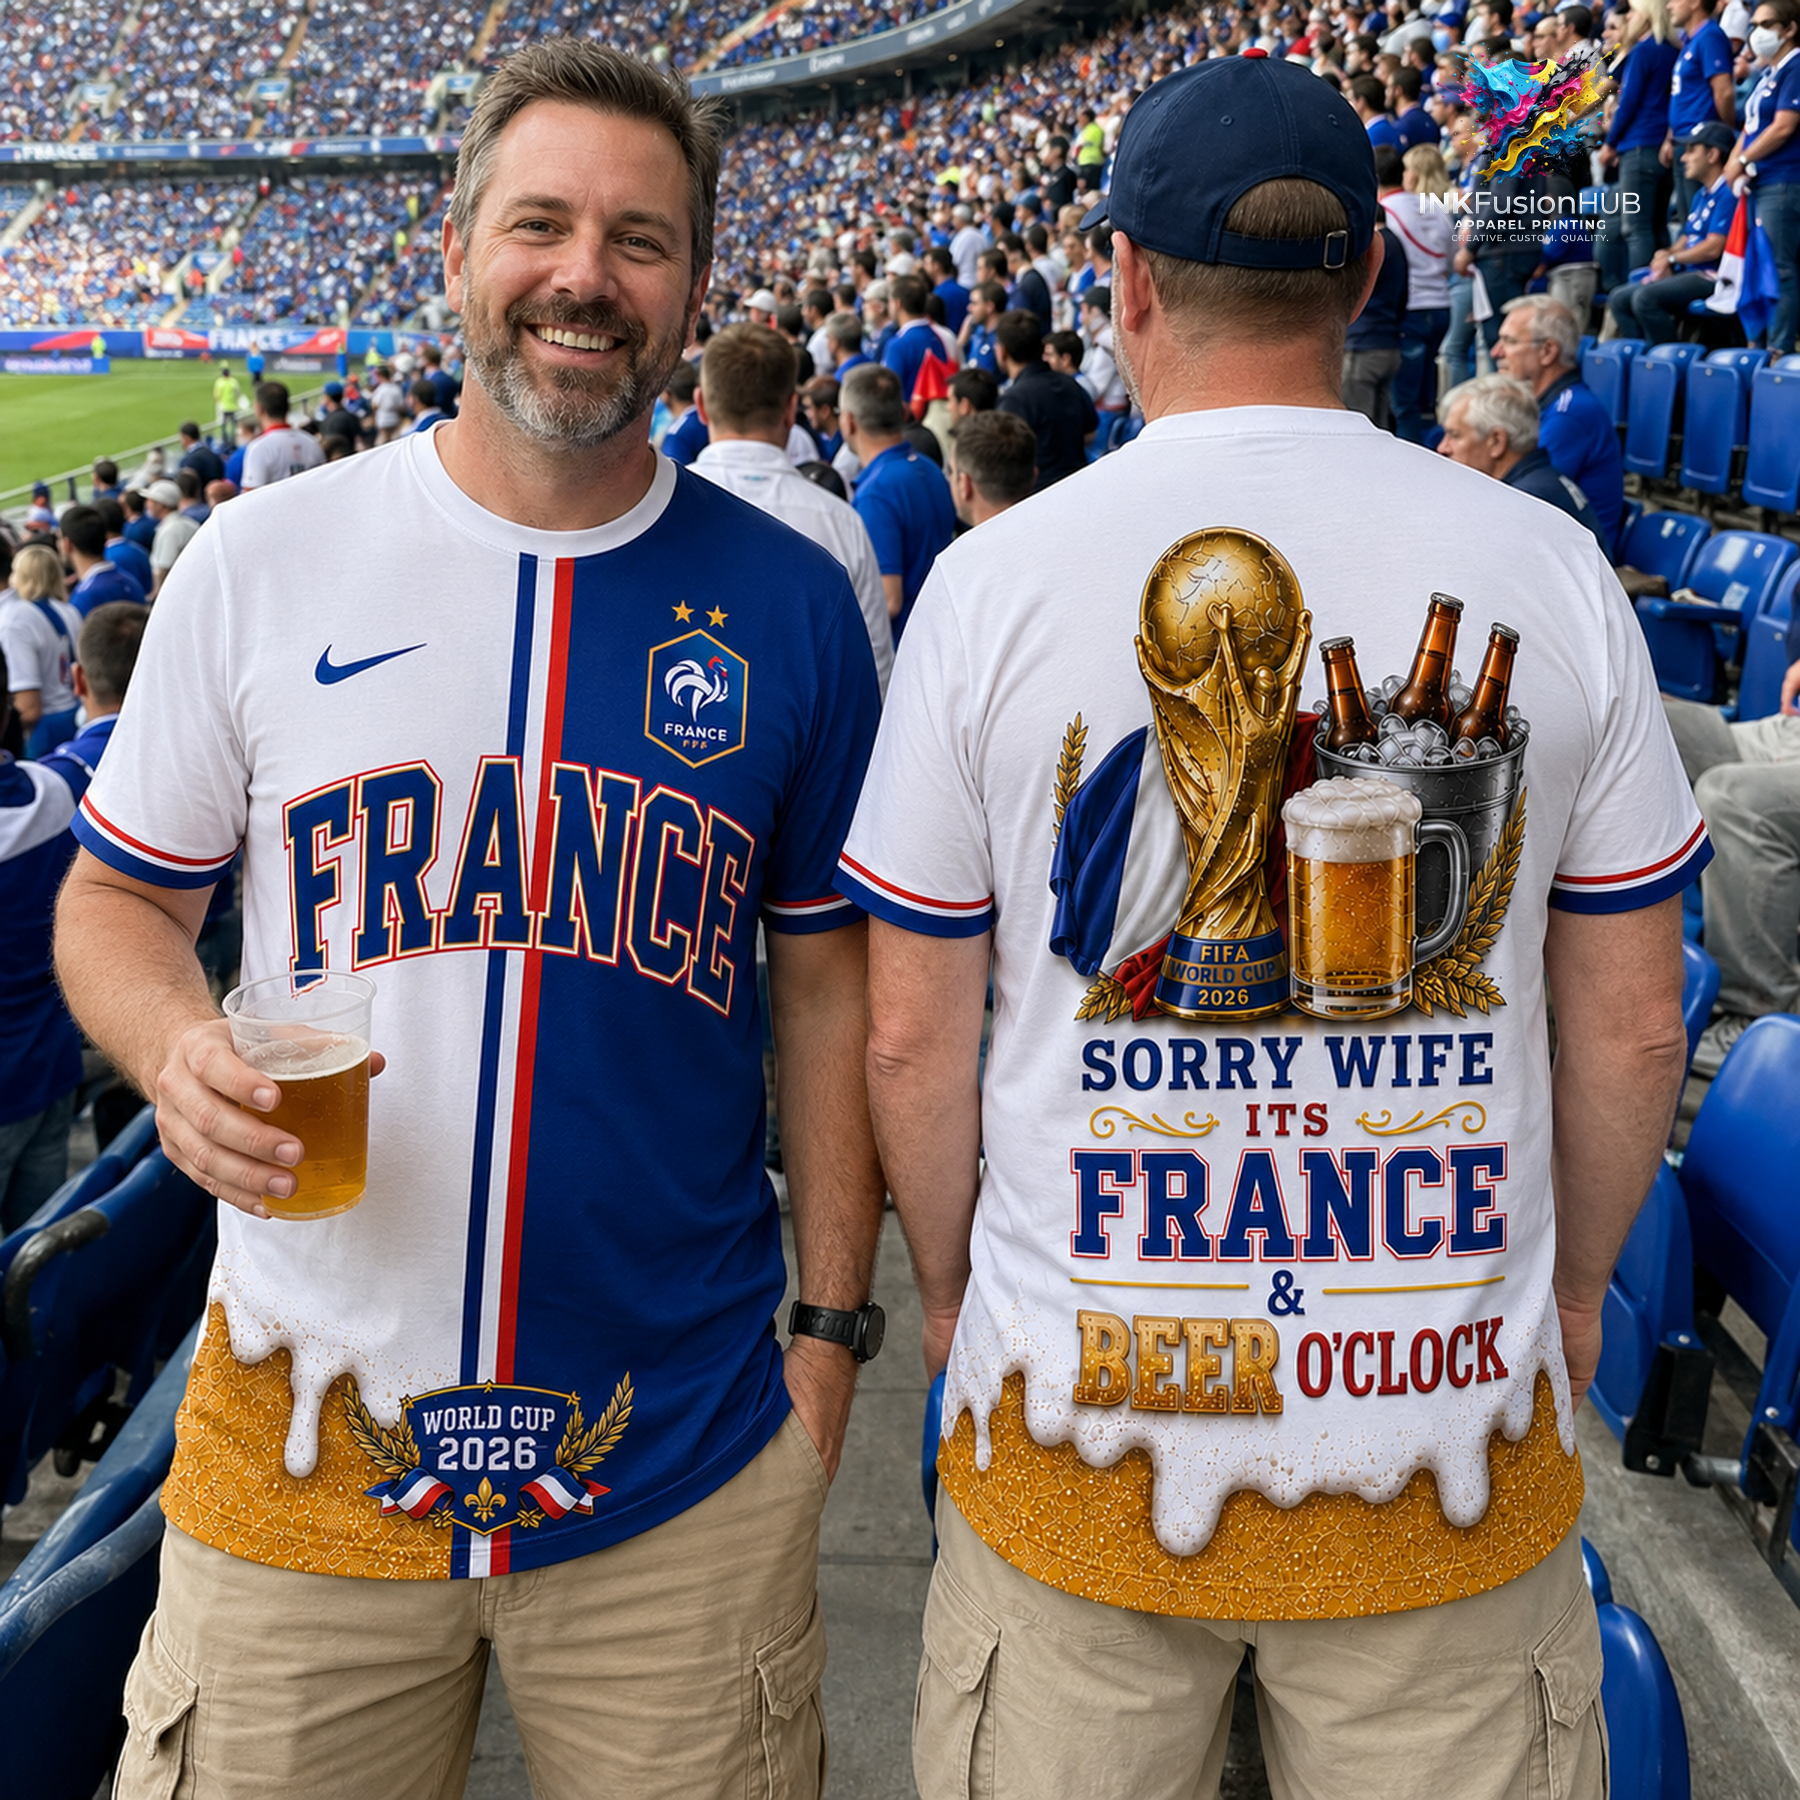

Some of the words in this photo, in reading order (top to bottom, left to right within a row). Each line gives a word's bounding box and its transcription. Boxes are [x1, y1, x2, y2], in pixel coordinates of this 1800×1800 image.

[664, 723, 727, 742] FRANCE
[282, 755, 755, 1017] FRANCE
[1200, 945, 1249, 962] FIFA
[1169, 963, 1236, 983] WORLD
[1241, 962, 1276, 982] CUP
[1198, 989, 1249, 1005] 2026
[1081, 1036, 1302, 1091] SORRY
[1324, 1032, 1494, 1088] WIFE
[1246, 1103, 1329, 1137] ITS
[1070, 1142, 1508, 1262] FRANCE
[1267, 1269, 1305, 1316] &
[1073, 1309, 1284, 1415] BEER
[1298, 1316, 1508, 1398] O'CLOCK
[422, 1405, 502, 1435] WORLD
[510, 1406, 556, 1432] CUP
[437, 1436, 536, 1471] 2026
